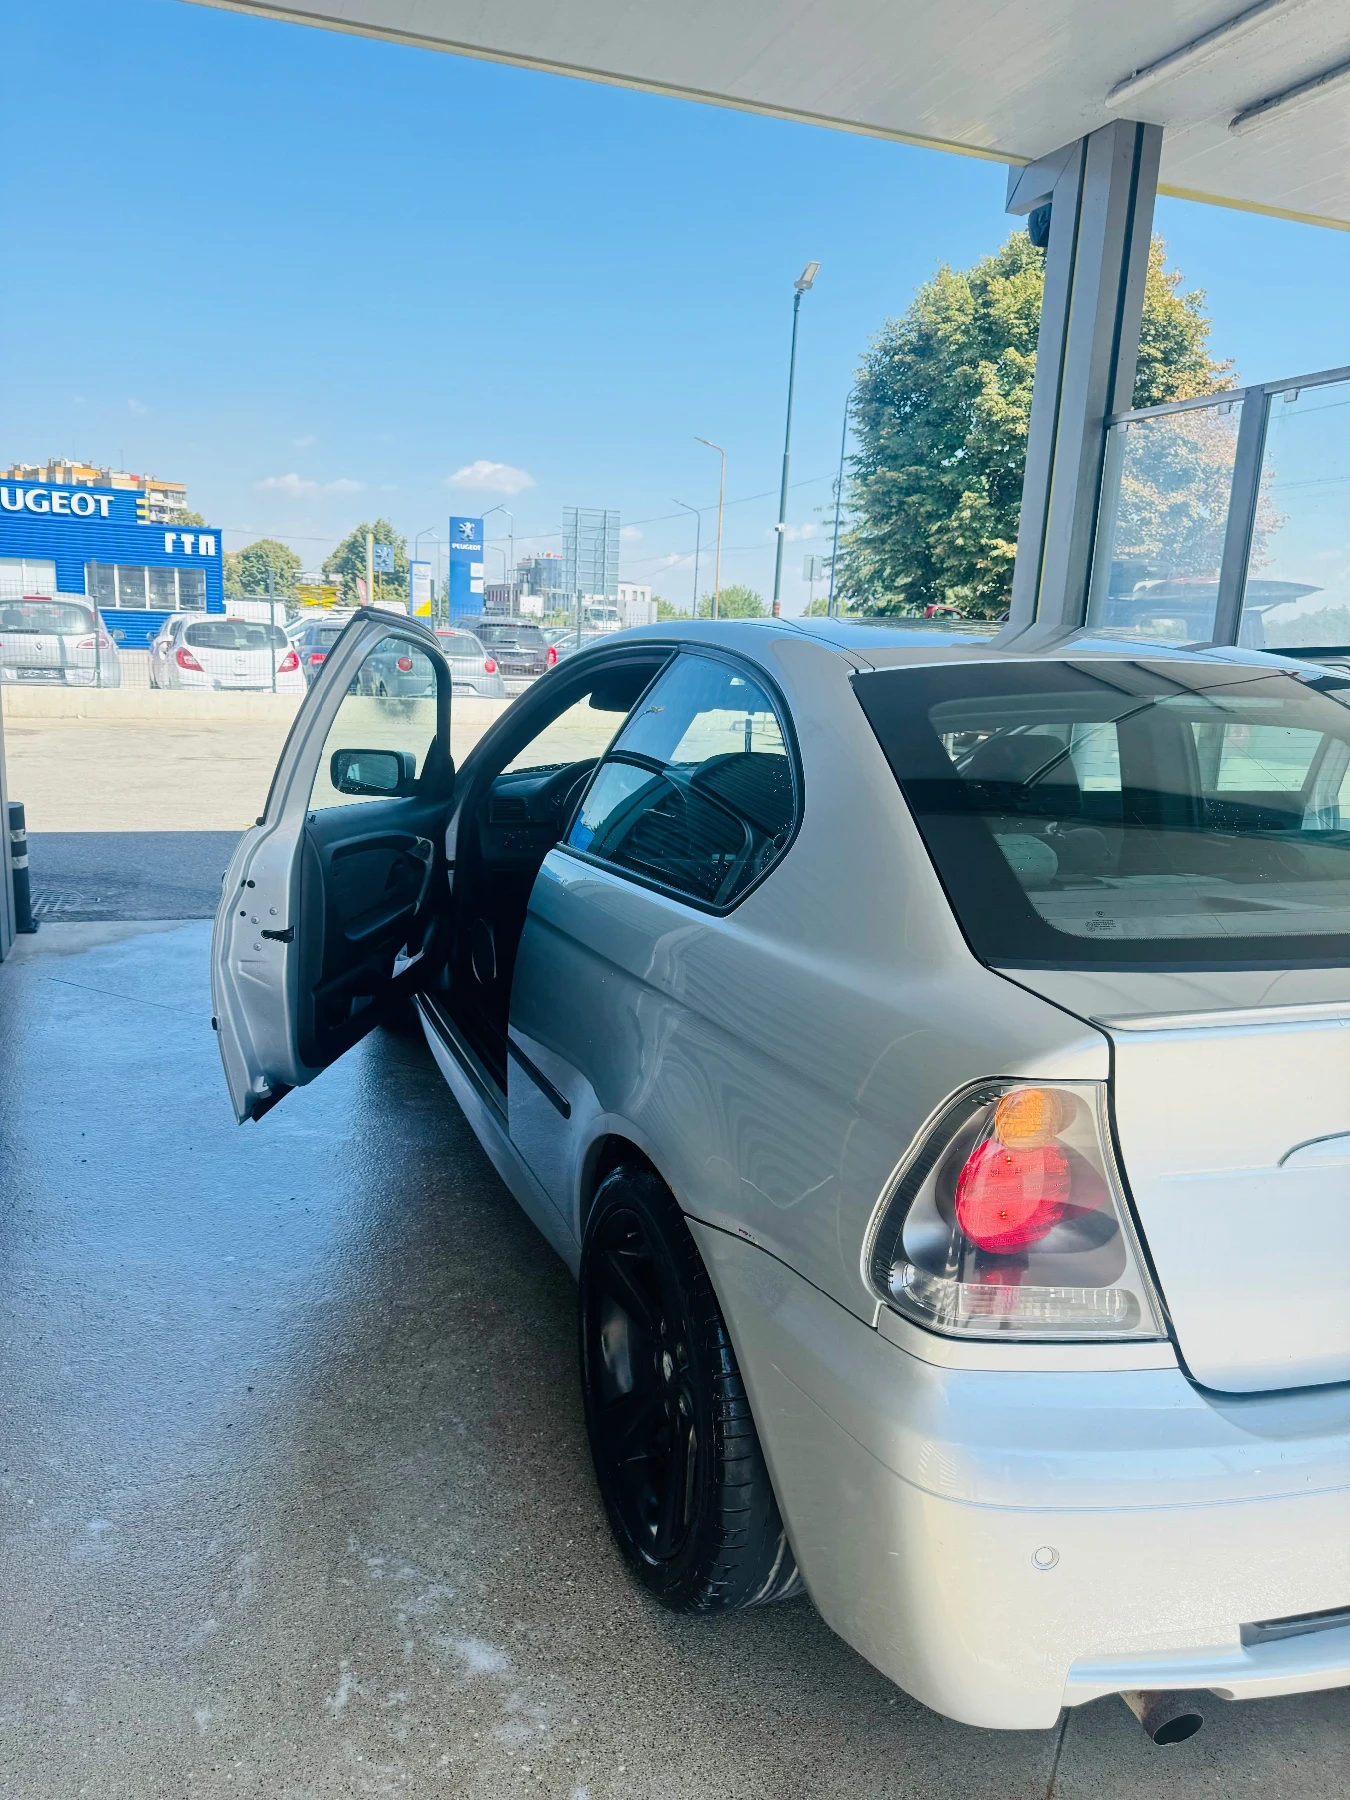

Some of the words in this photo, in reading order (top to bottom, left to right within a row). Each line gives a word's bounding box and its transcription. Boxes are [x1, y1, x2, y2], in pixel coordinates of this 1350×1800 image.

[0, 487, 114, 517] UGEOT
[165, 532, 216, 556] ГТП
[452, 543, 482, 551] PEUGEOT
